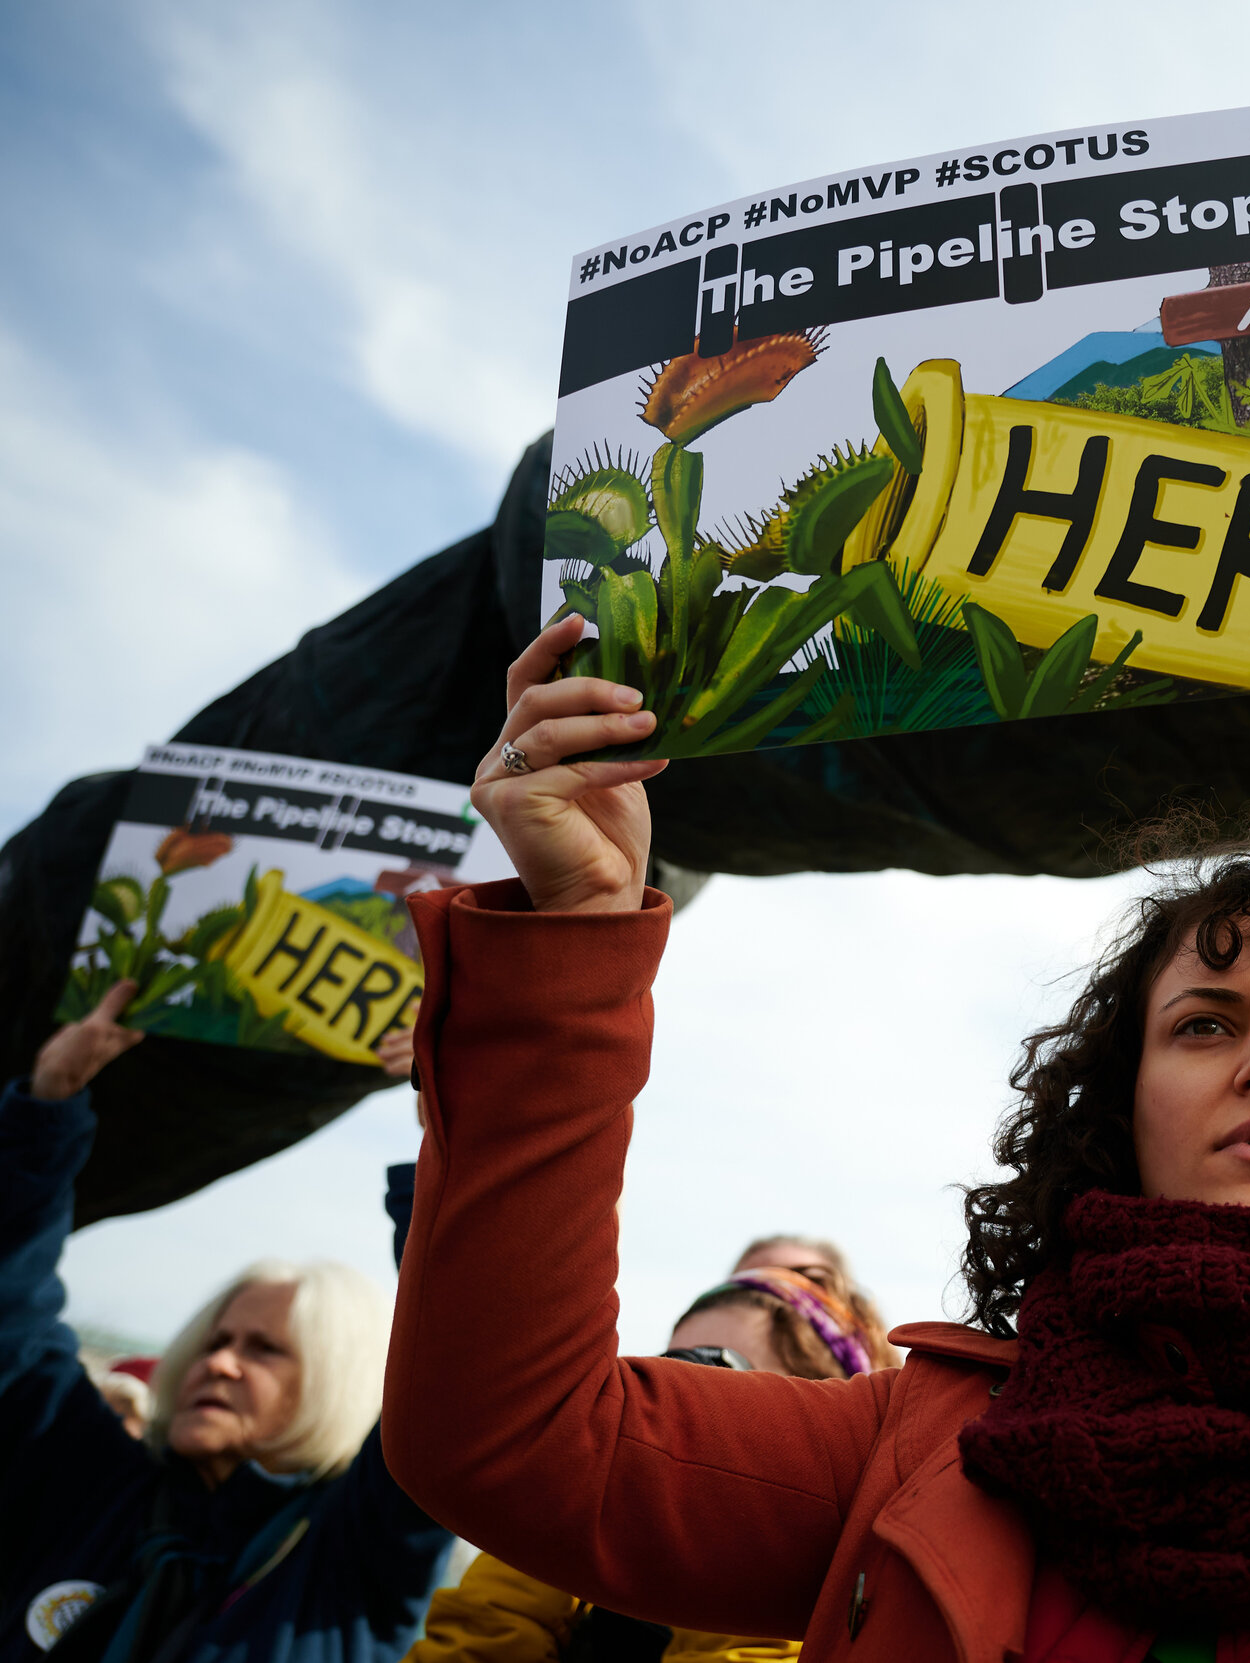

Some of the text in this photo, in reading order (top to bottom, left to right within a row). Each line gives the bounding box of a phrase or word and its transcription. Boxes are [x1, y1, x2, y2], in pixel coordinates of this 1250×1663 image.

[580, 129, 1150, 284] #NoACP #NoMVP #SCOTUS
[703, 266, 815, 315] The
[837, 214, 1097, 287] Pipeline
[196, 788, 472, 853] The Pipeline Stops
